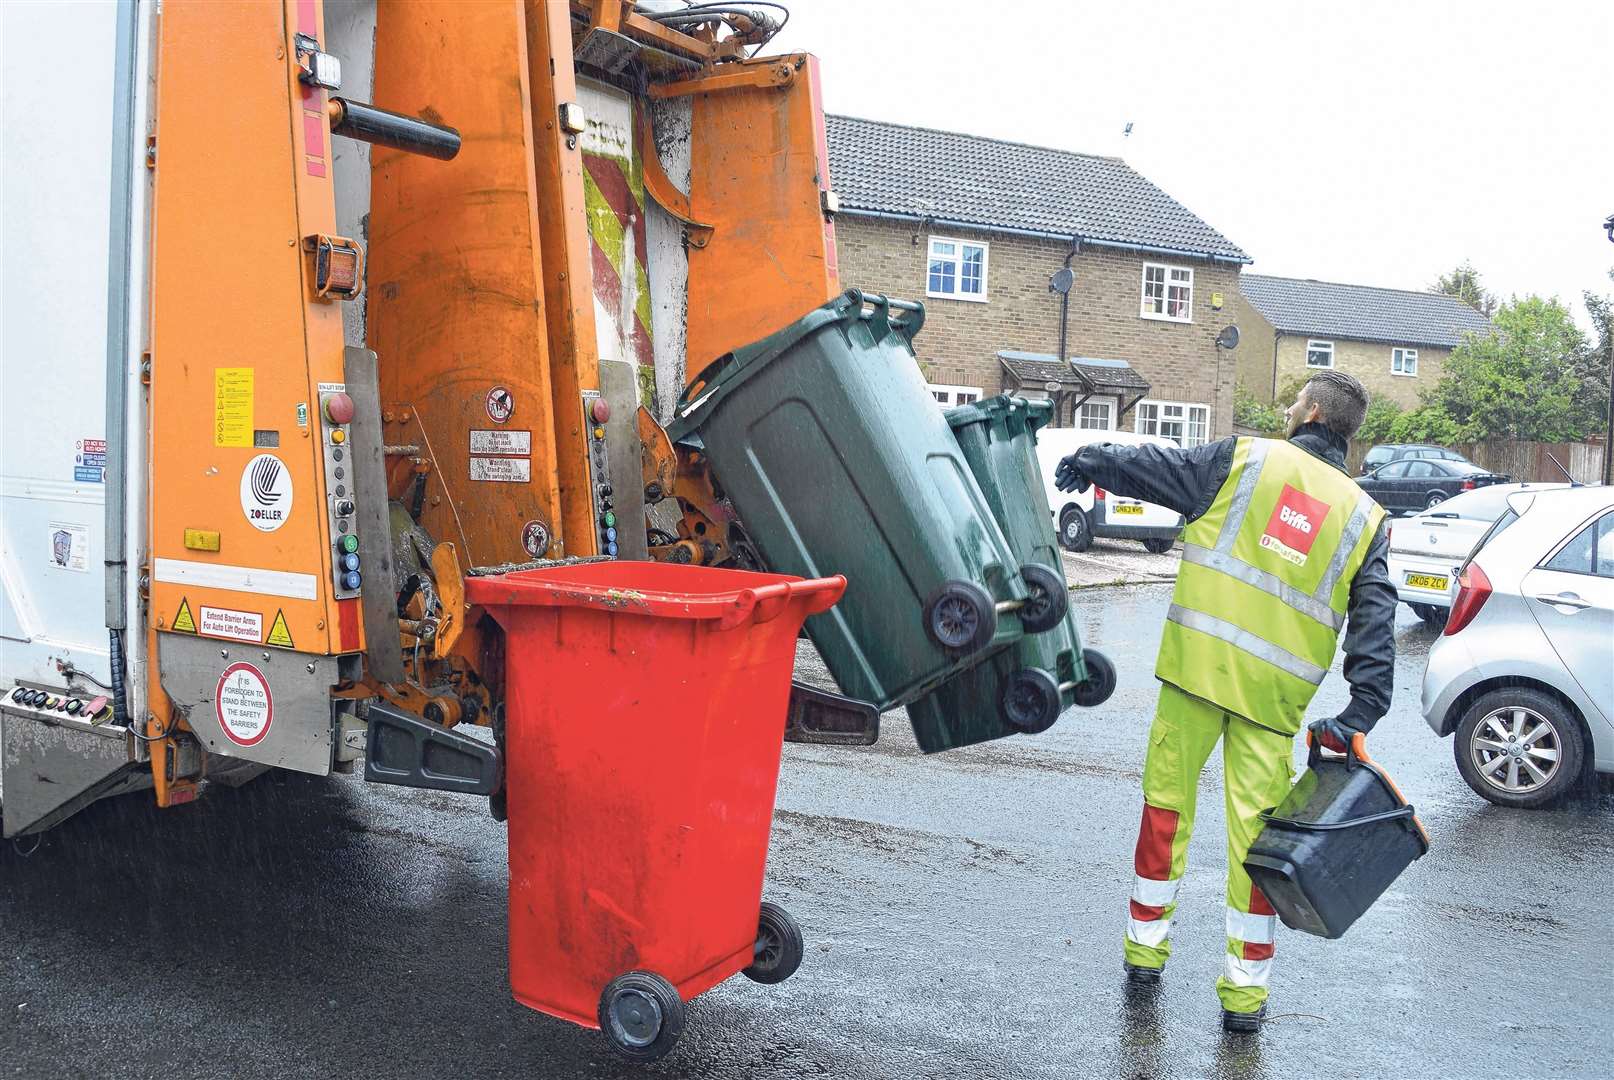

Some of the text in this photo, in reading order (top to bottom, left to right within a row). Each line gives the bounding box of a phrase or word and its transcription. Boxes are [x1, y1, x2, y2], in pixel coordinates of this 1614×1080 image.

[491, 432, 508, 440] Warning
[490, 459, 510, 467] Warning
[250, 509, 282, 520] ZOELLER
[1280, 504, 1312, 534] Biffa
[206, 611, 256, 626] Extend Barrier Arms
[203, 621, 260, 637] For Auto Lift Operation
[224, 686, 254, 696] FORBIDDEN
[222, 697, 266, 708] STAND BETWEEN
[240, 710, 260, 718] SAFETY
[230, 720, 258, 728] BARRIERS
